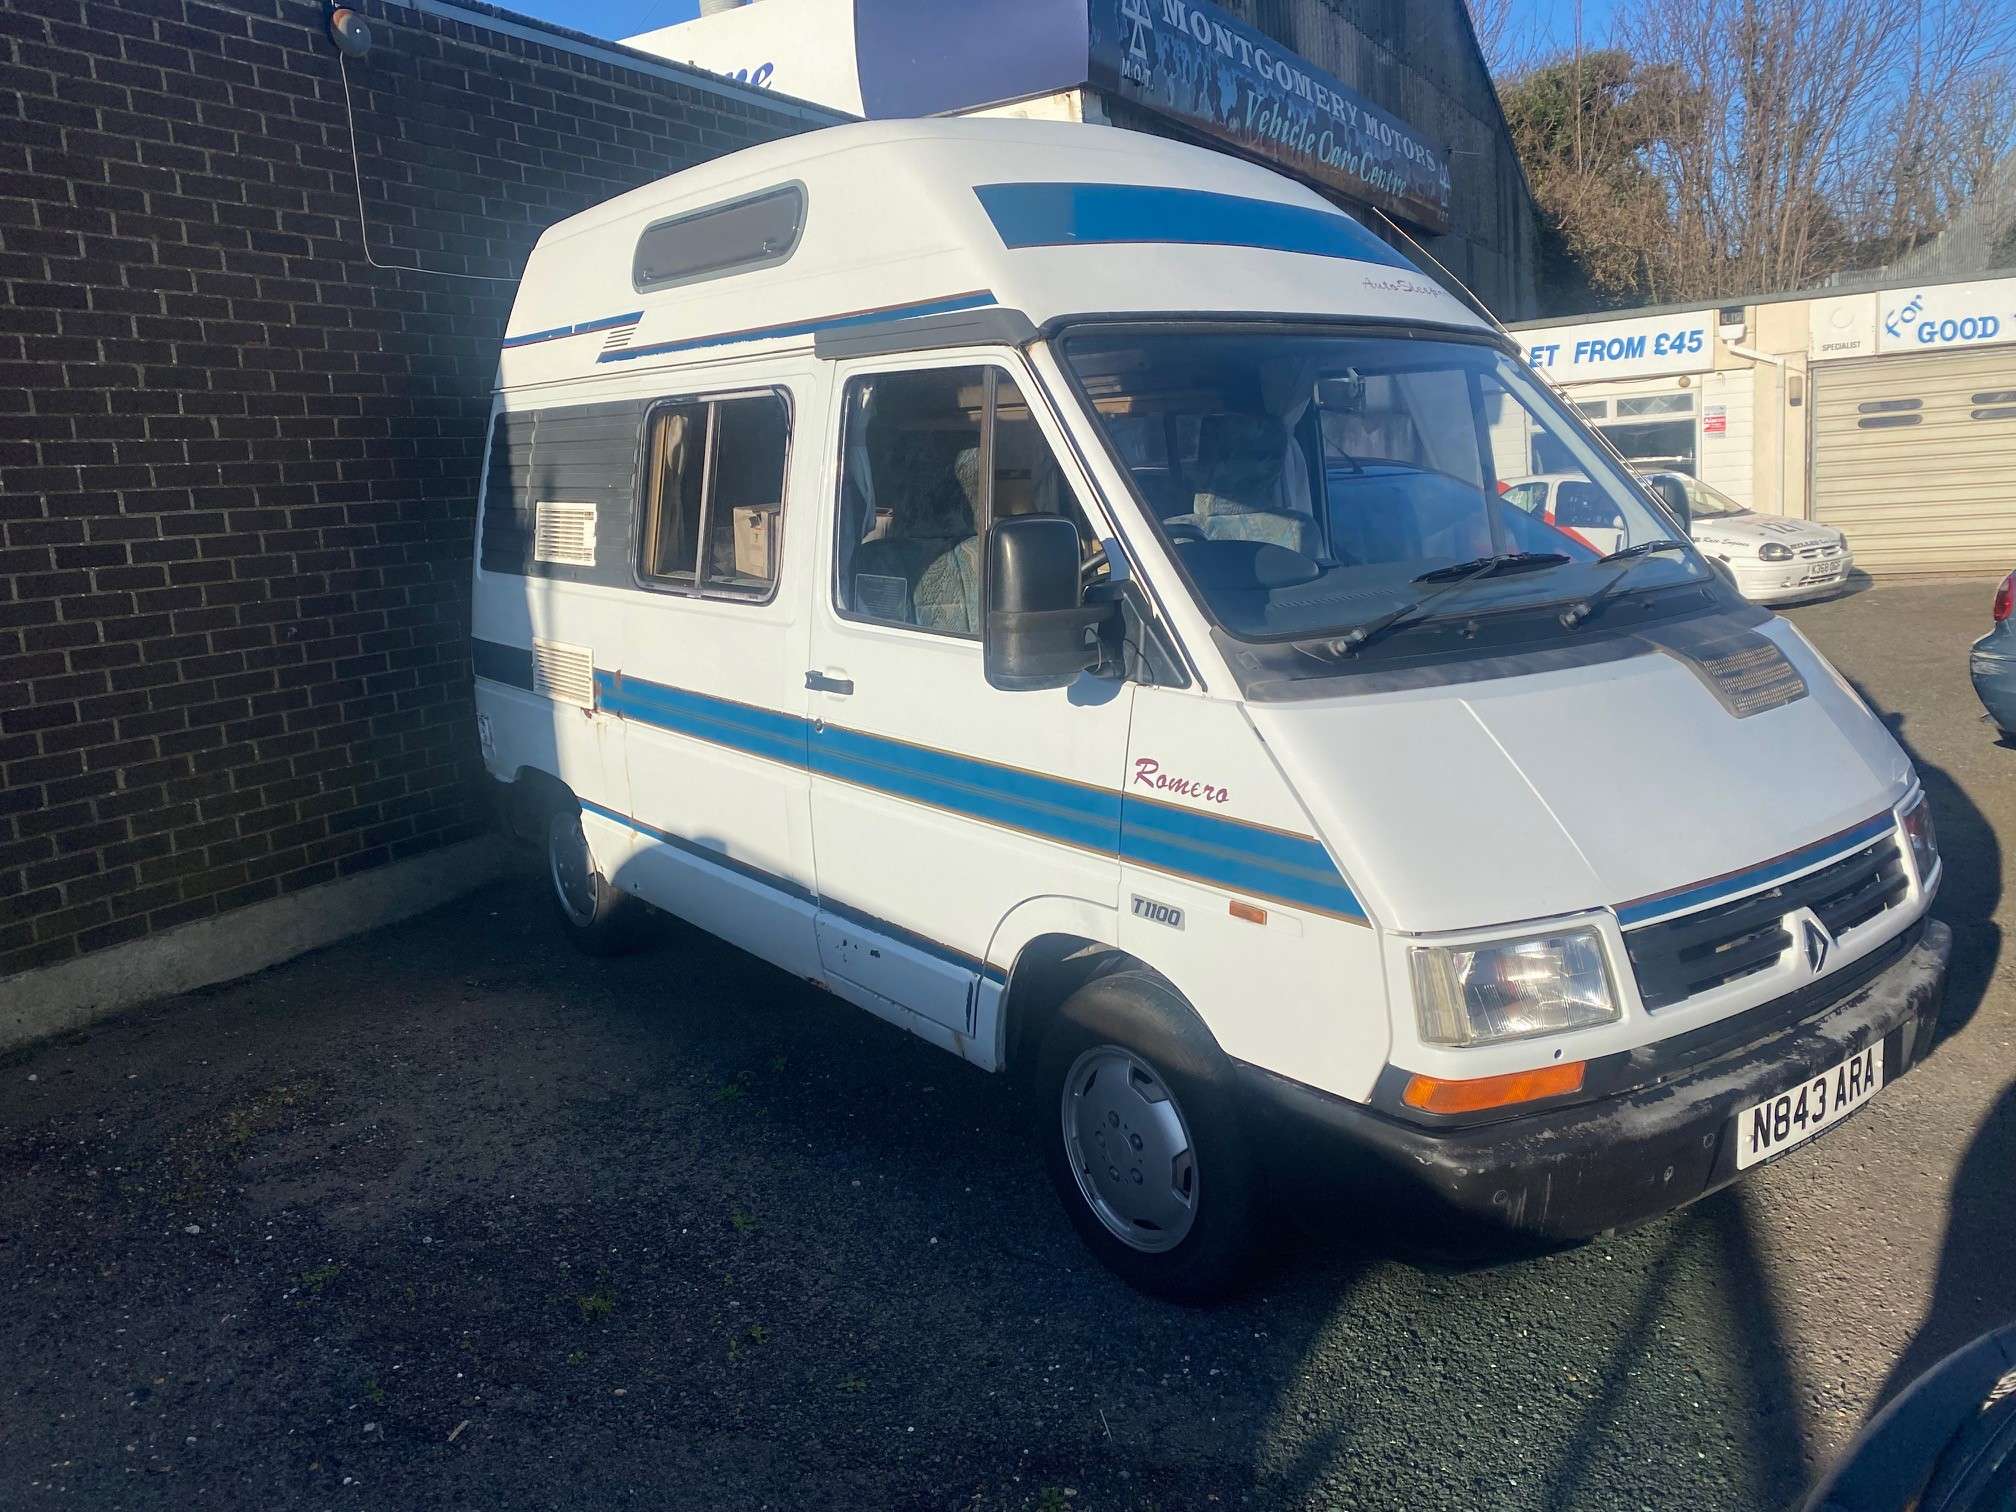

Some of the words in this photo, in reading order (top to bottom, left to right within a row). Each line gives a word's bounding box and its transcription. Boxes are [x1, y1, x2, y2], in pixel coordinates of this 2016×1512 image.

[1162, 0, 1357, 127] MONTGOMERY
[1363, 111, 1436, 172] MOTORS
[1245, 89, 1316, 155] Vehicle
[1318, 130, 1358, 176] Care
[1360, 151, 1408, 198] Centre
[1573, 336, 1647, 364] FROM
[1654, 329, 1704, 355] £45
[1821, 340, 1861, 352] SPECIALIST
[1917, 316, 2000, 343] GOOD
[1133, 757, 1230, 804] Romero
[1133, 898, 1181, 927] T1100
[1752, 1077, 1828, 1154] N843
[1834, 1047, 1875, 1112] ARA
